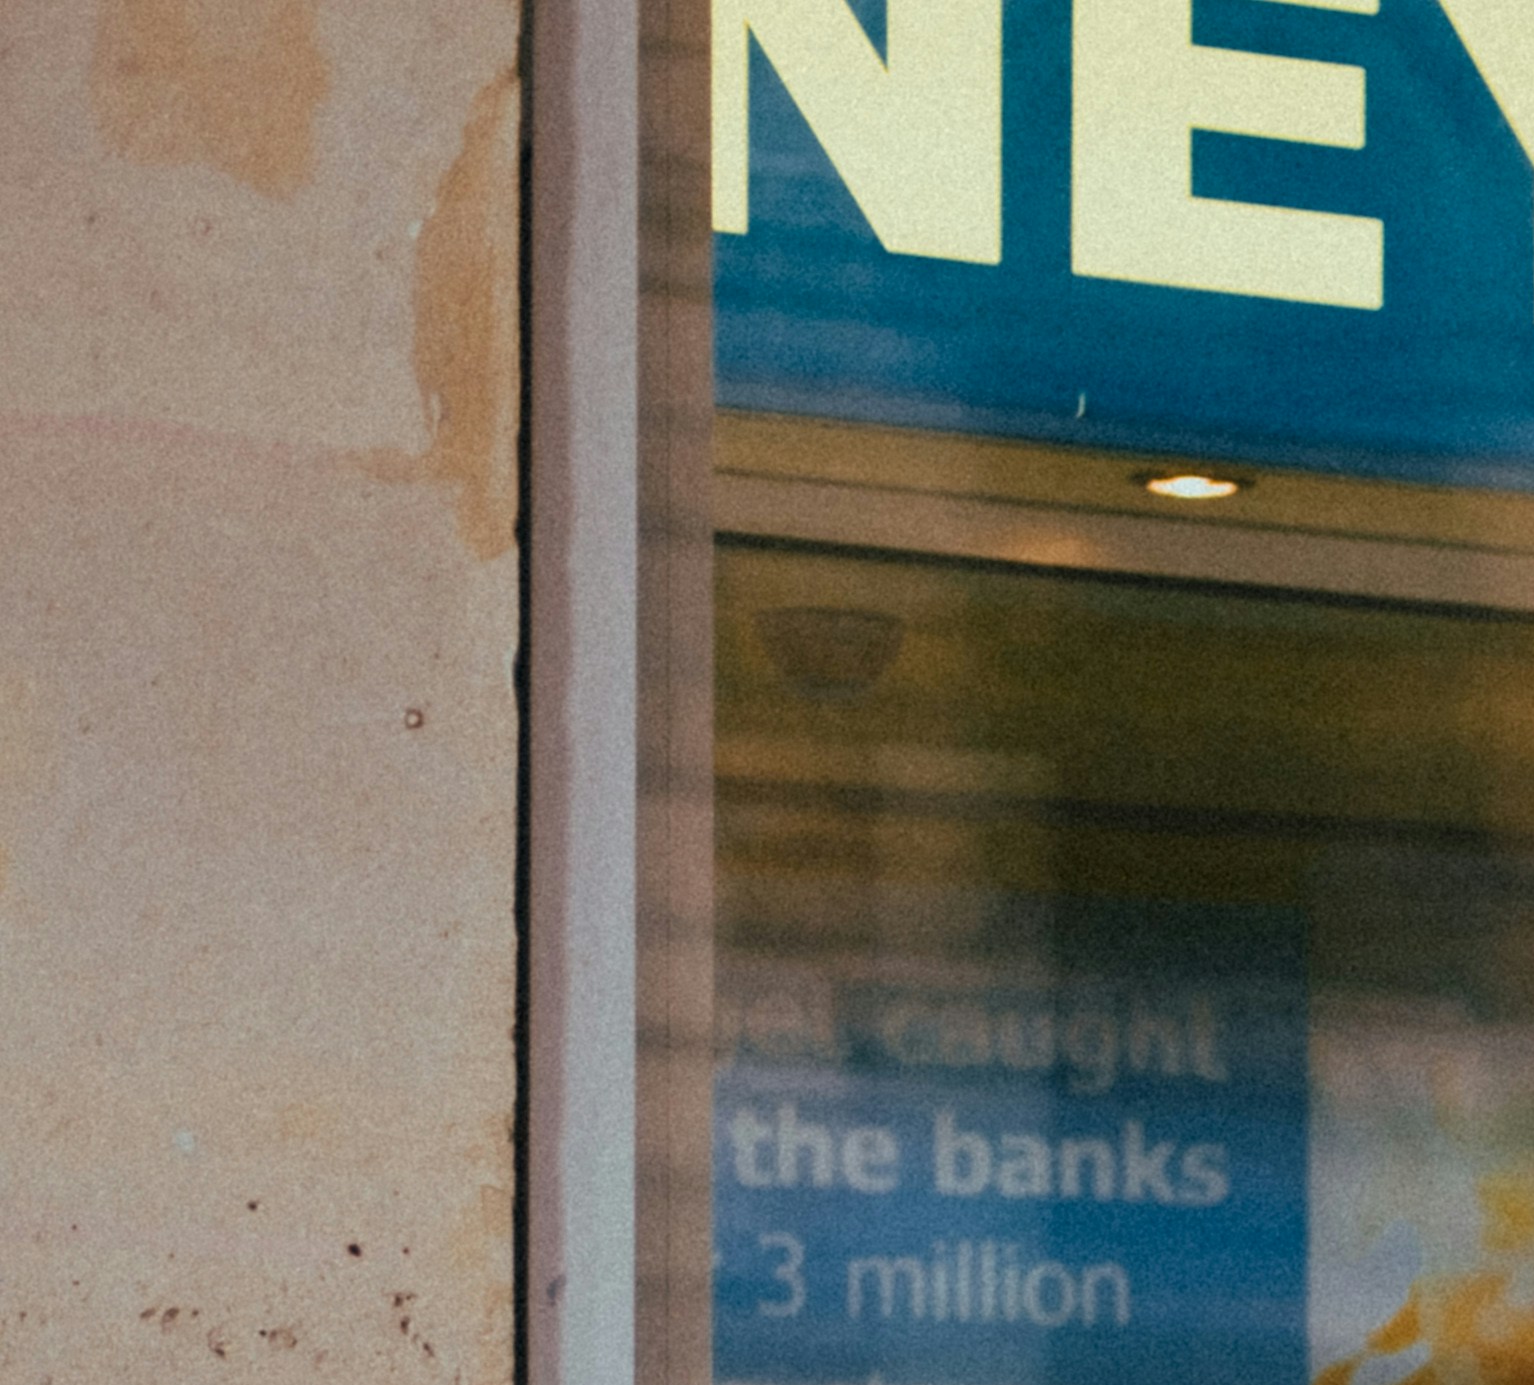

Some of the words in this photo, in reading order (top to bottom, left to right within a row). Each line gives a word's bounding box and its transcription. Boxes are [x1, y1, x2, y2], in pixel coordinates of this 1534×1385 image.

[880, 997, 1231, 1094] caught
[729, 1103, 899, 1195] the
[933, 1109, 1231, 1207] banks
[756, 1231, 807, 1320] 3
[846, 1237, 1133, 1327] million
